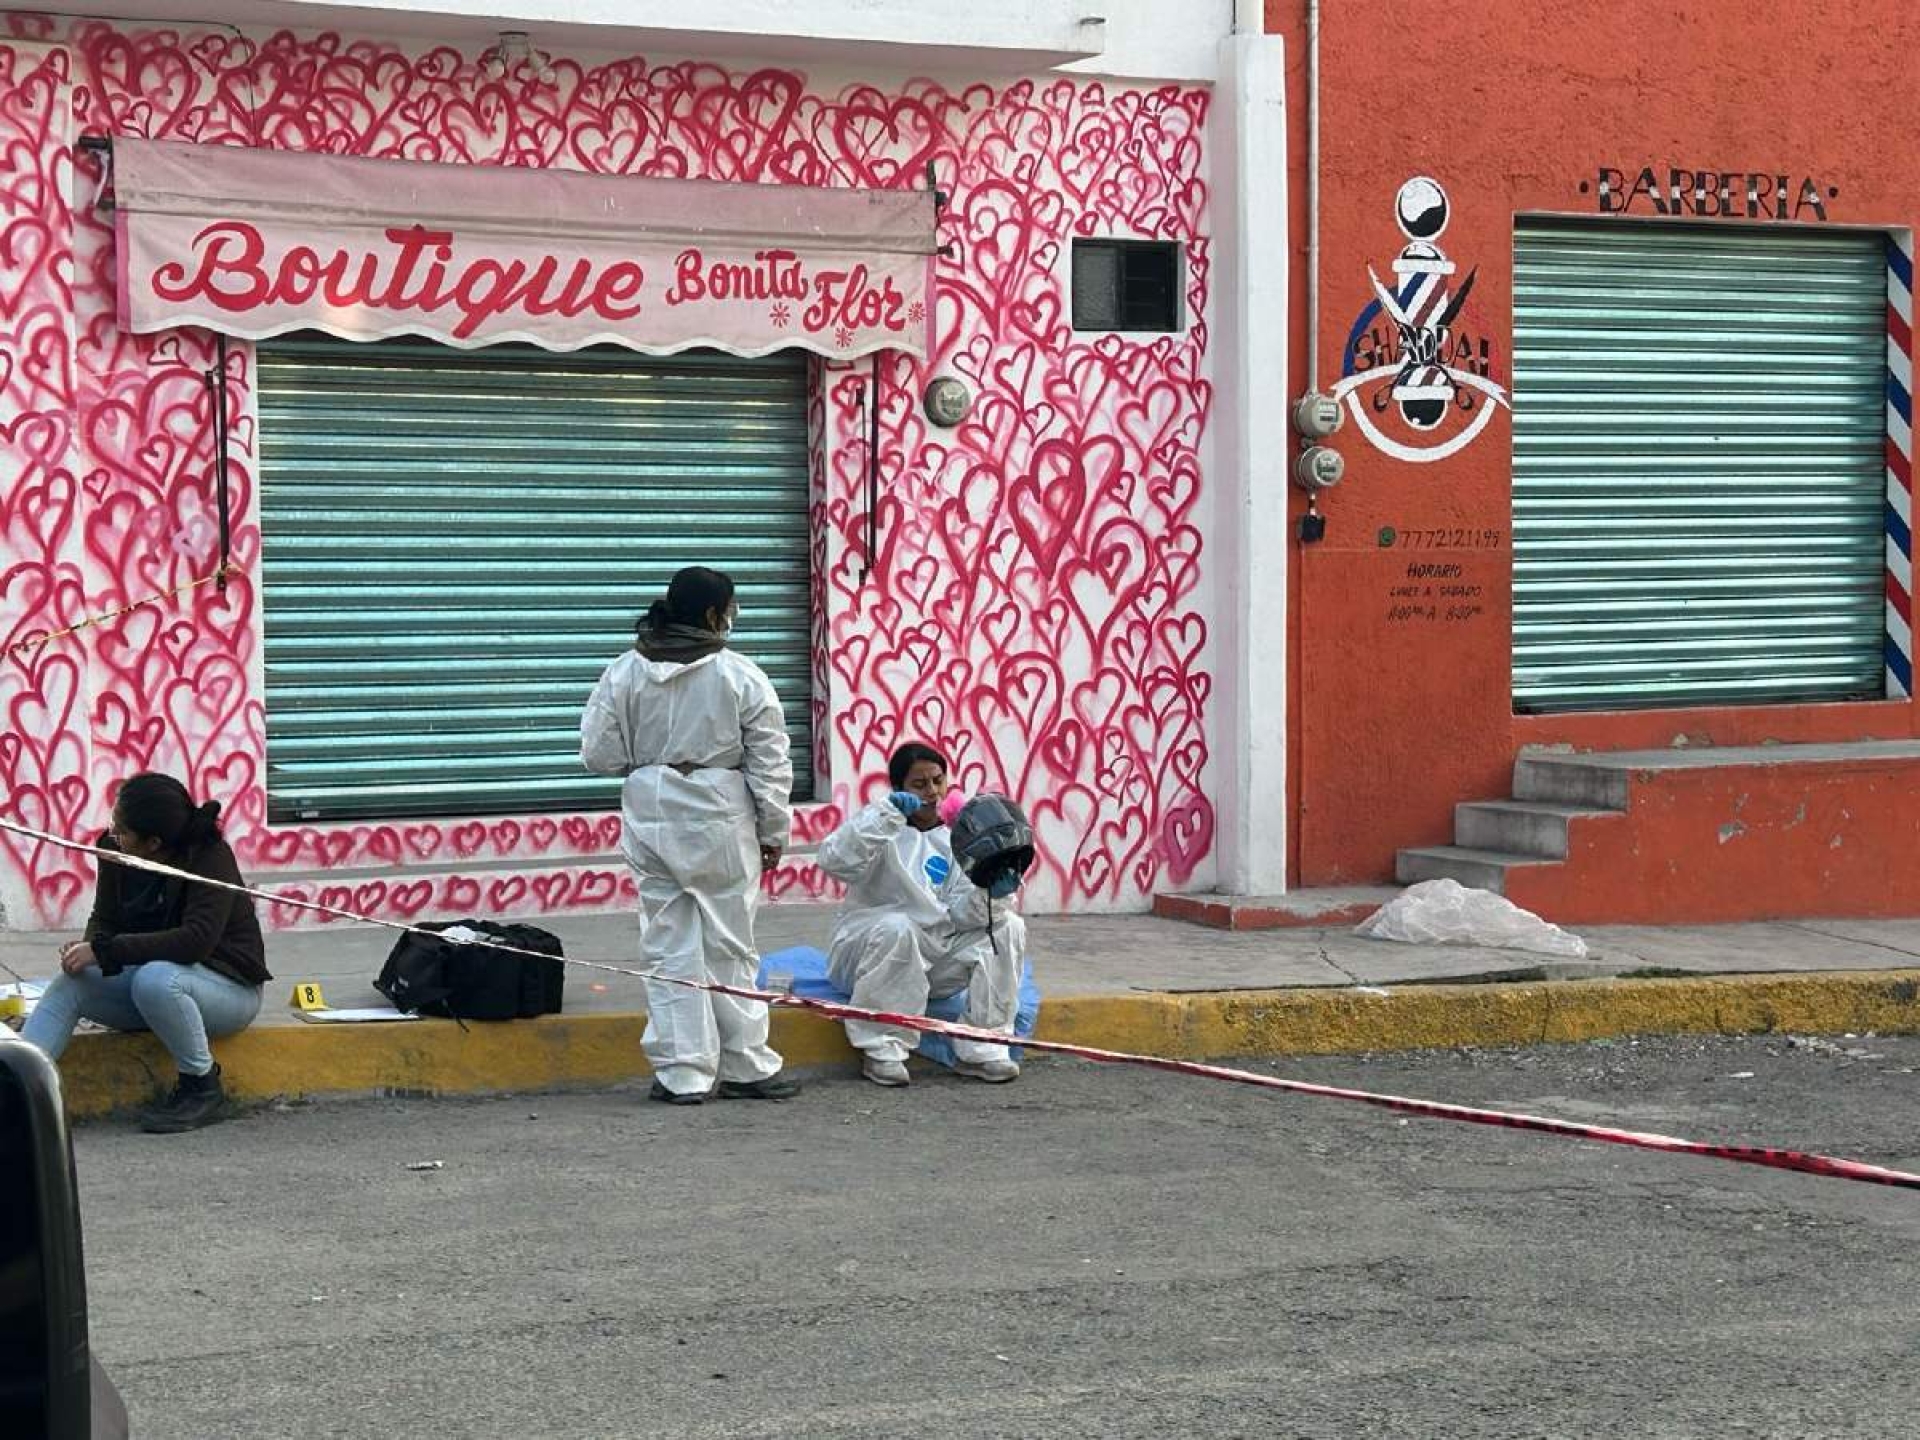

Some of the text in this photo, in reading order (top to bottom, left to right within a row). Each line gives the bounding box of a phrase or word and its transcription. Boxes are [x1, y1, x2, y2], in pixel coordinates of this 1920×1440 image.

[1600, 167, 1826, 221] BARBERIA
[152, 222, 905, 338] Boutique Bonita Flor
[1407, 563, 1461, 578] HORARIO
[305, 986, 315, 1003] 8
